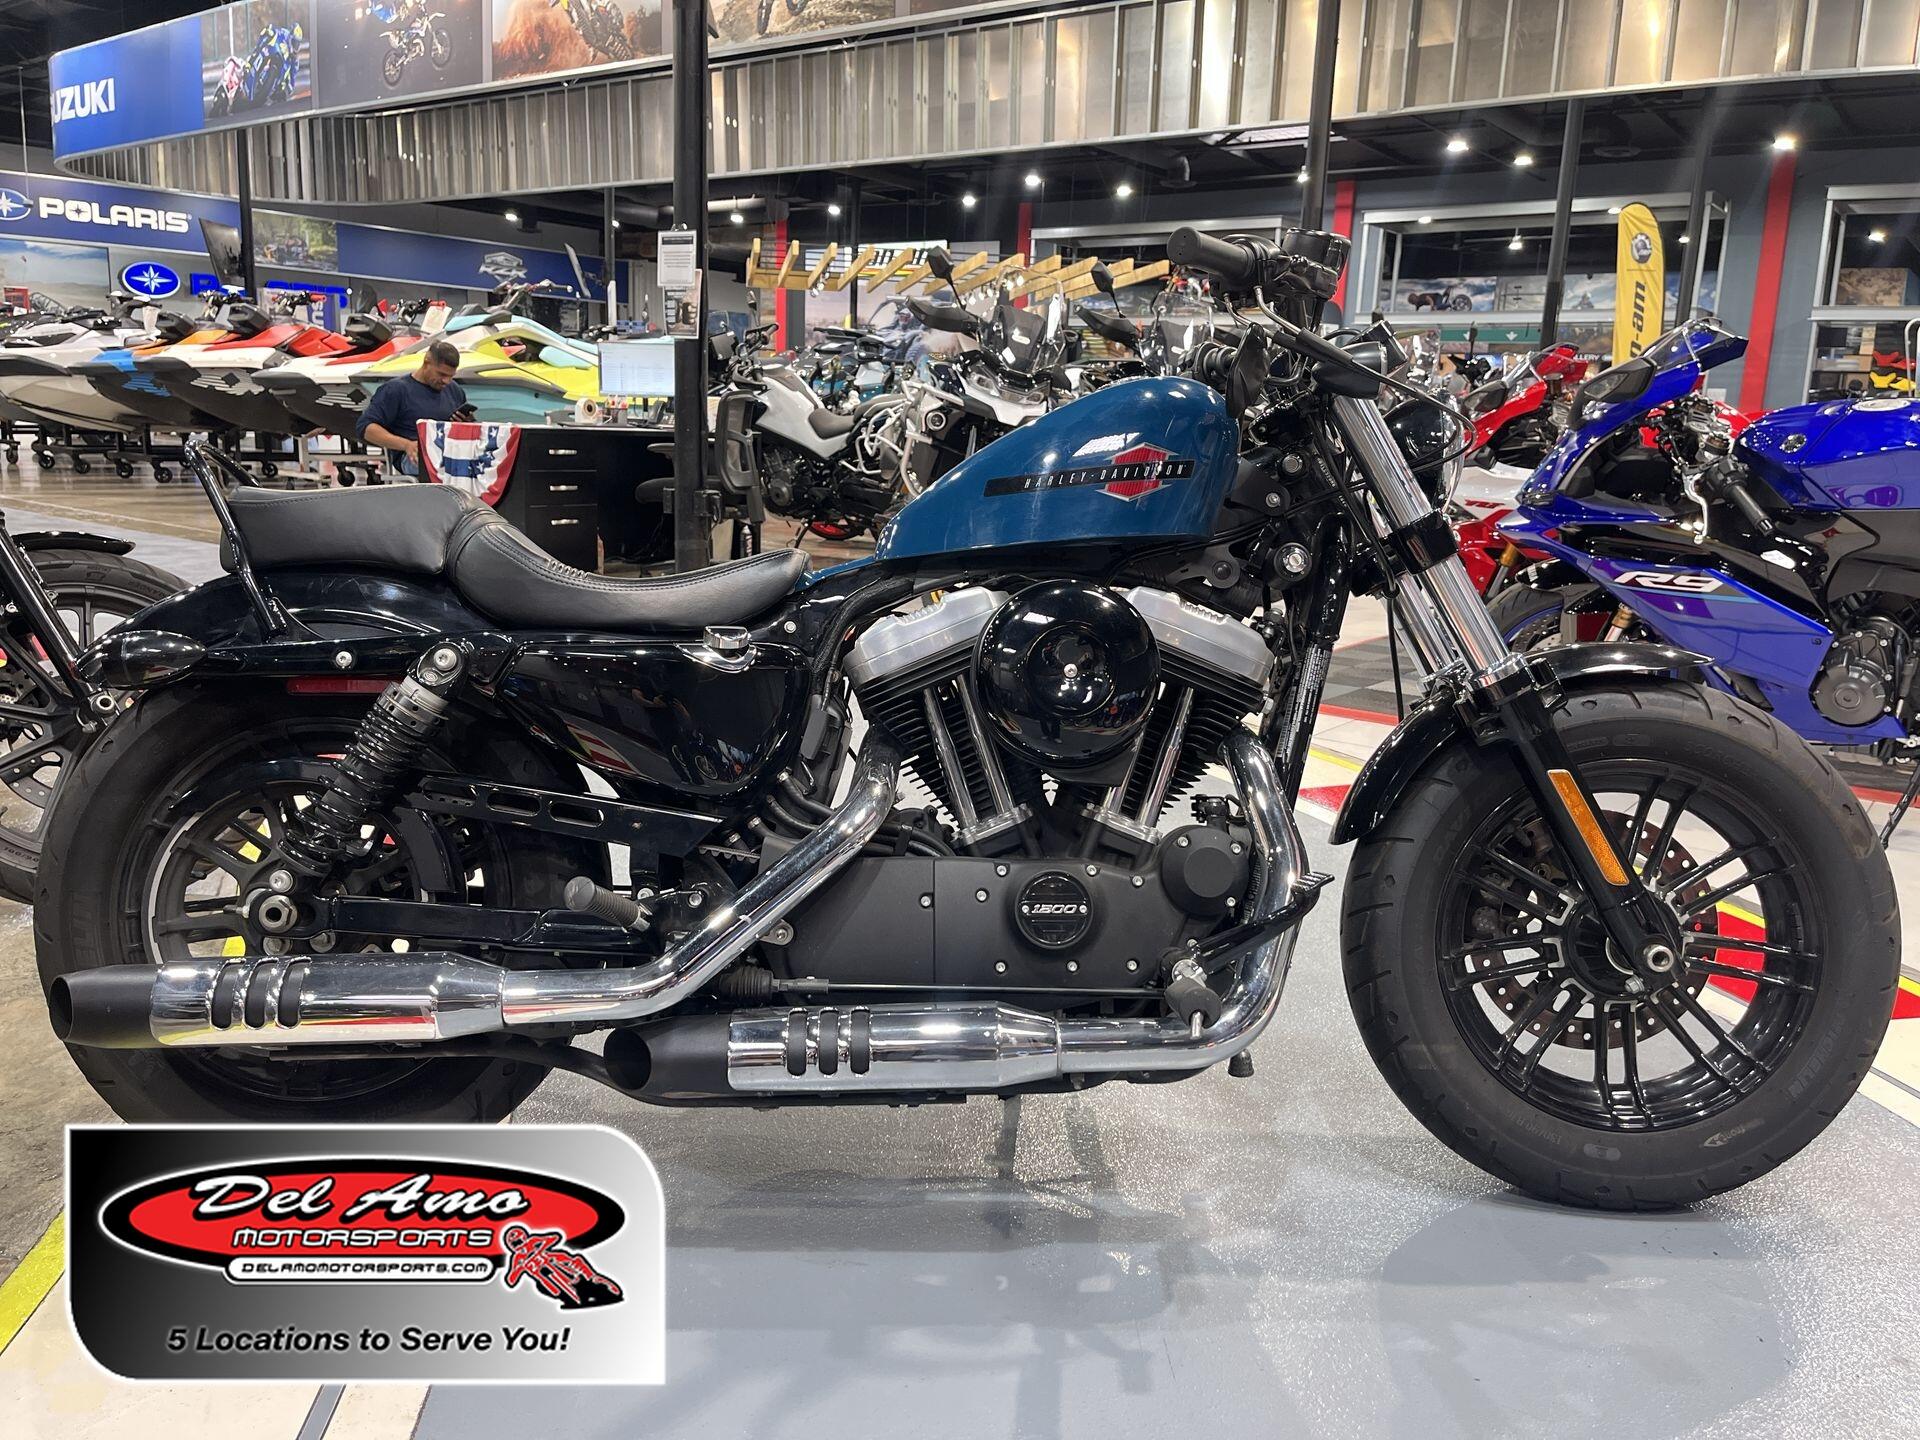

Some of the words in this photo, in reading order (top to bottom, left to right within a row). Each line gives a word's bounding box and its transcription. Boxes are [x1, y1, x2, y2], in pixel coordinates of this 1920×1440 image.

[50, 77, 115, 126] UZUKI
[39, 197, 190, 233] POLARIS
[1630, 280, 1646, 358] n-am
[1572, 353, 1600, 362] LLERY
[1613, 571, 1723, 593] R9
